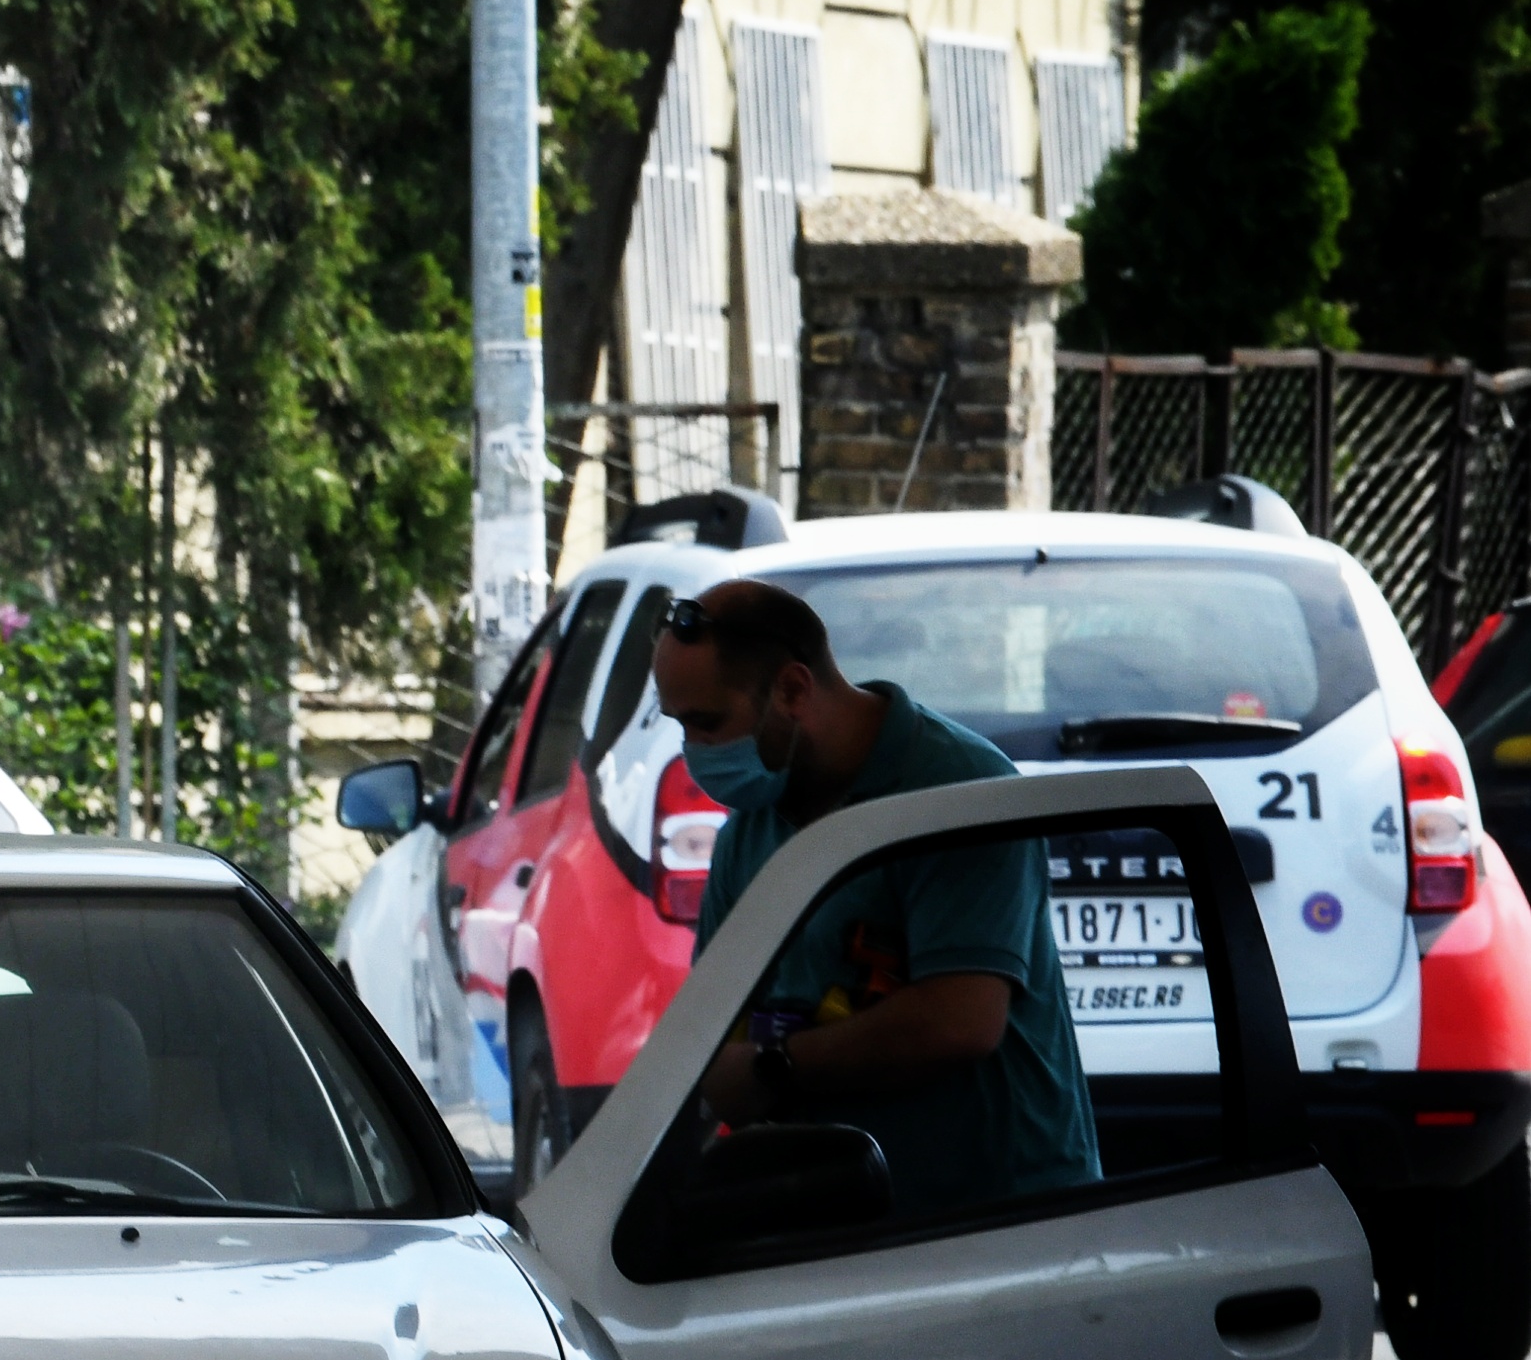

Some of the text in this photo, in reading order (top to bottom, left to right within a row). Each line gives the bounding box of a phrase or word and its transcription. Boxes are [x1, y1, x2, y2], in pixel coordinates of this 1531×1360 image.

[1258, 770, 1322, 821] 21
[1371, 805, 1398, 838] 4
[1048, 856, 1186, 879] STER
[1311, 901, 1332, 924] C
